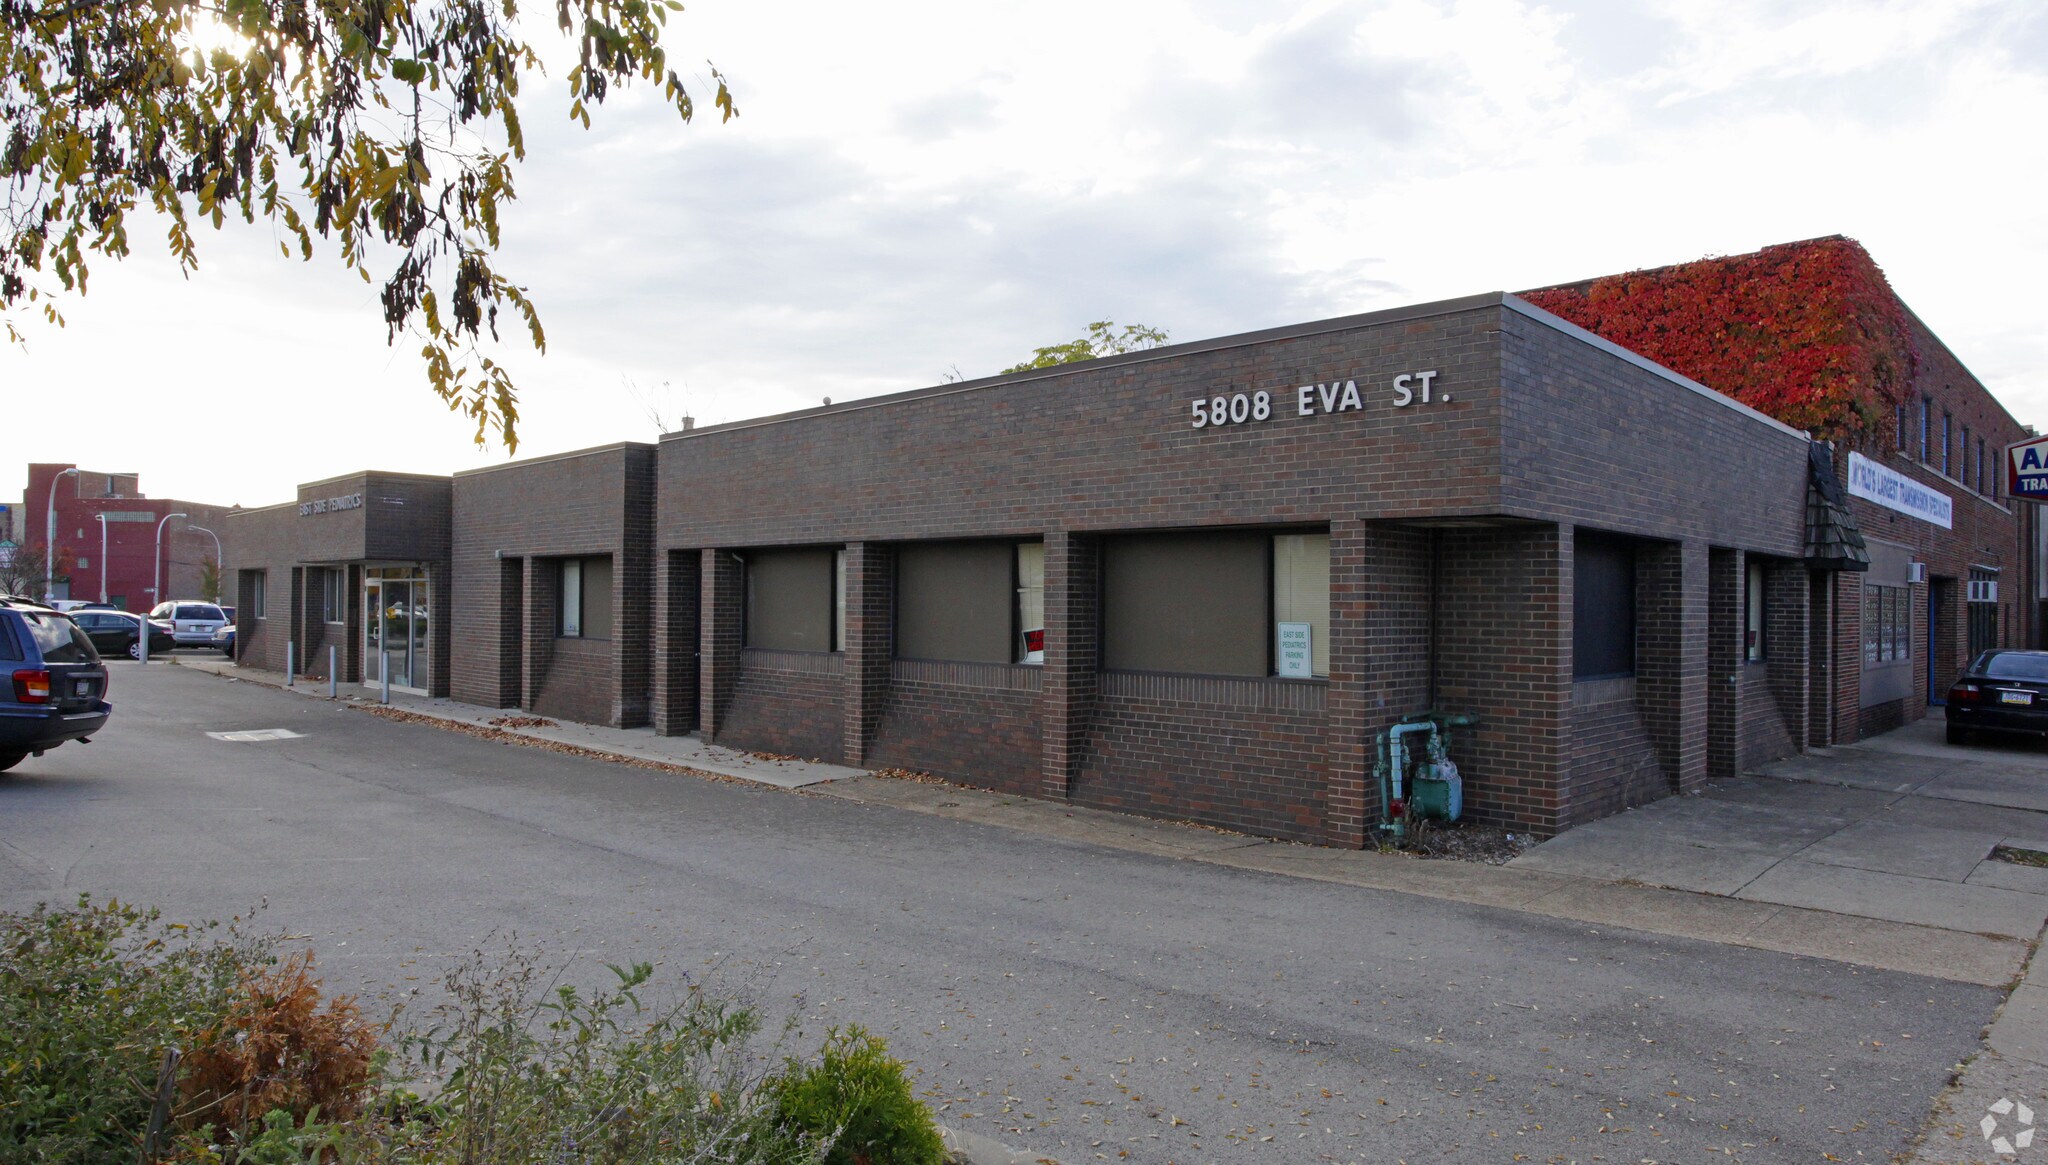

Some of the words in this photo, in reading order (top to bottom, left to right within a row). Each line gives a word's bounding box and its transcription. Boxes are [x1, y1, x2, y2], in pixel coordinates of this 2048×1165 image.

[1192, 391, 1270, 428] 5808
[1299, 380, 1363, 416] EVA
[1393, 370, 1450, 407] ST.
[2020, 447, 2048, 470] A
[1295, 631, 1304, 639] SIDE
[1282, 641, 1306, 649] PEDIATRICS
